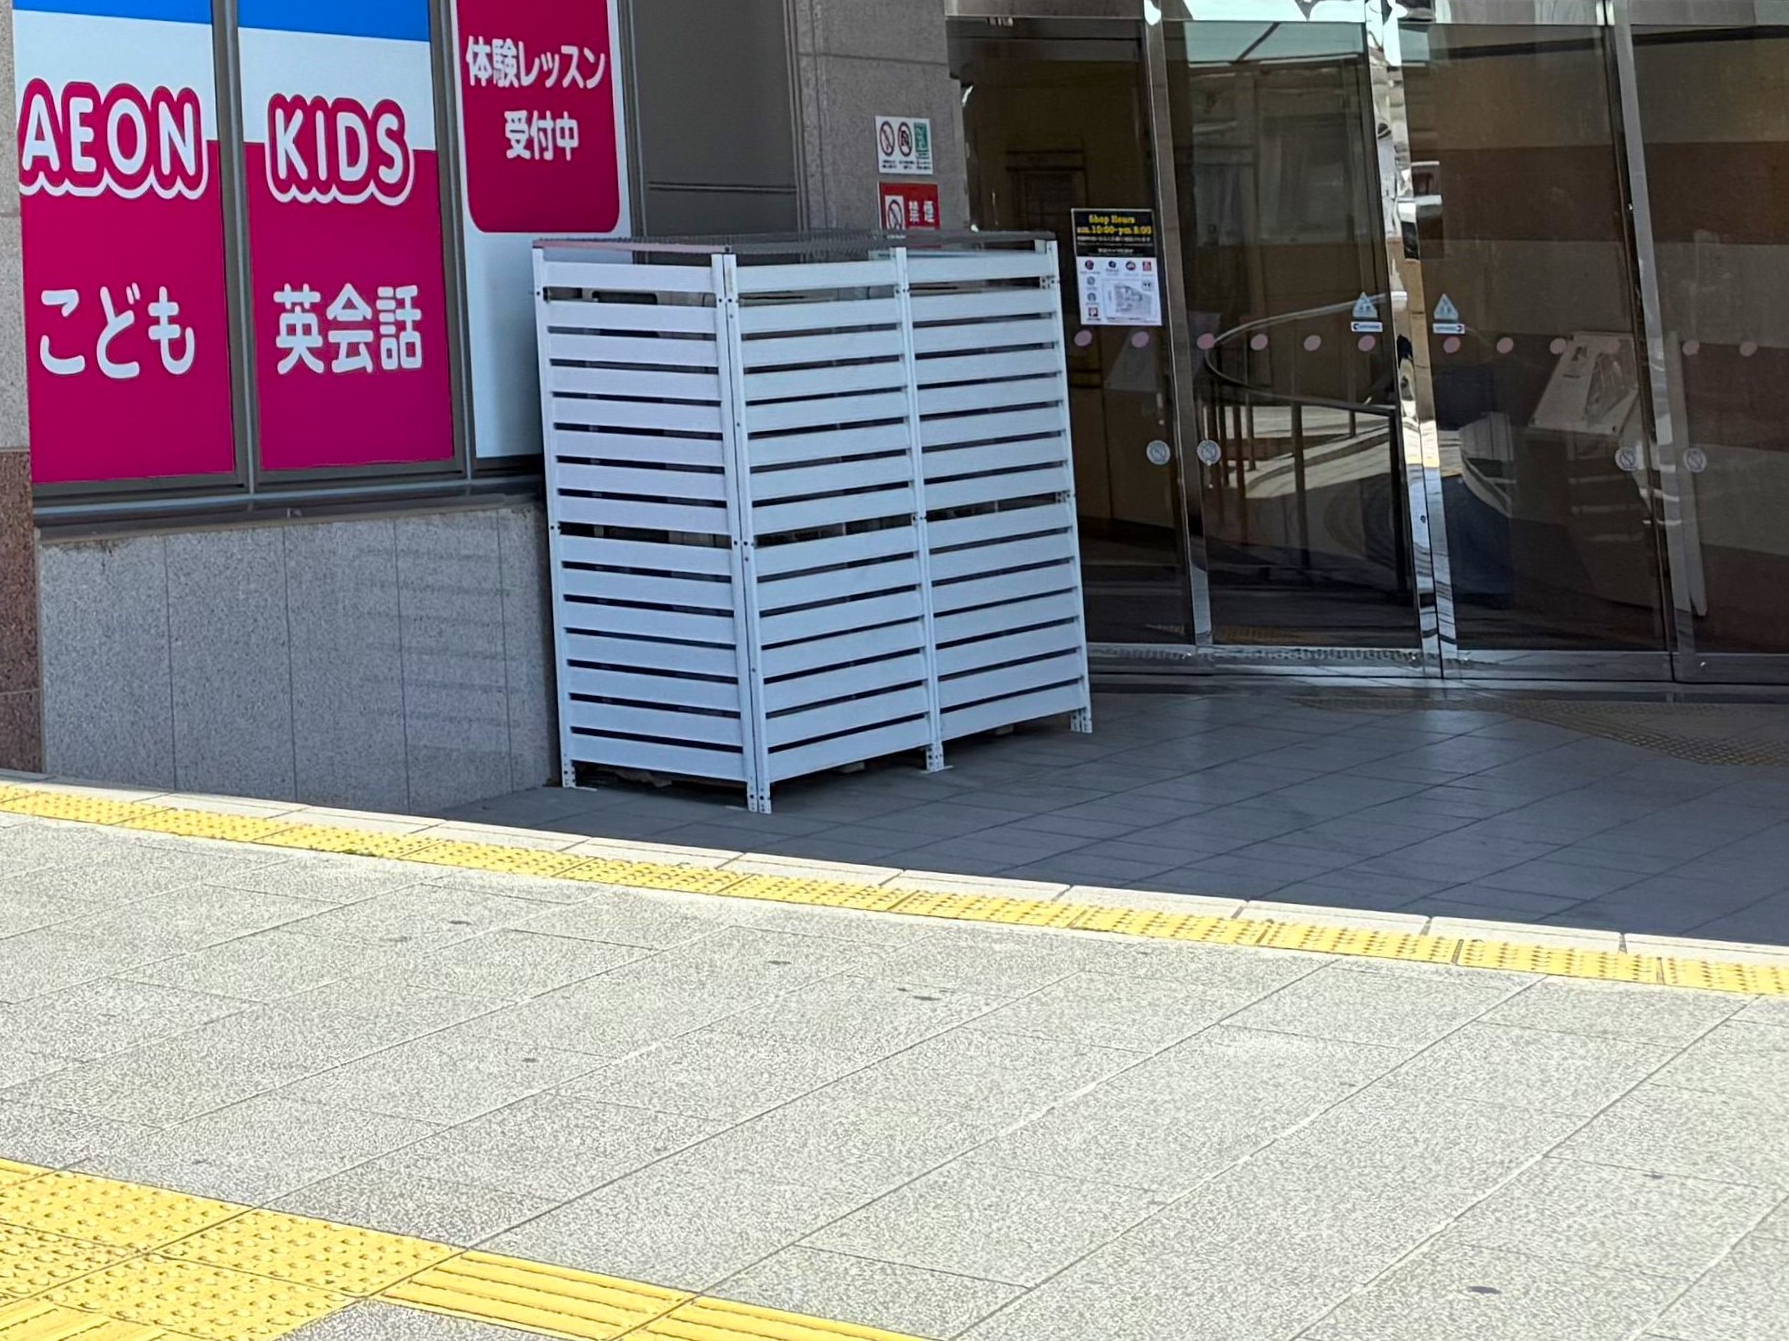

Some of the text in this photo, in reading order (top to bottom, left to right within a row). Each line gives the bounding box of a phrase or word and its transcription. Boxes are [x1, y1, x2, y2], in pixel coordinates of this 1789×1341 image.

[465, 35, 606, 91] 体験レッスン
[21, 86, 410, 196] AEON KIDS
[504, 109, 580, 162] 受付中
[38, 281, 423, 380] こども 英会話
